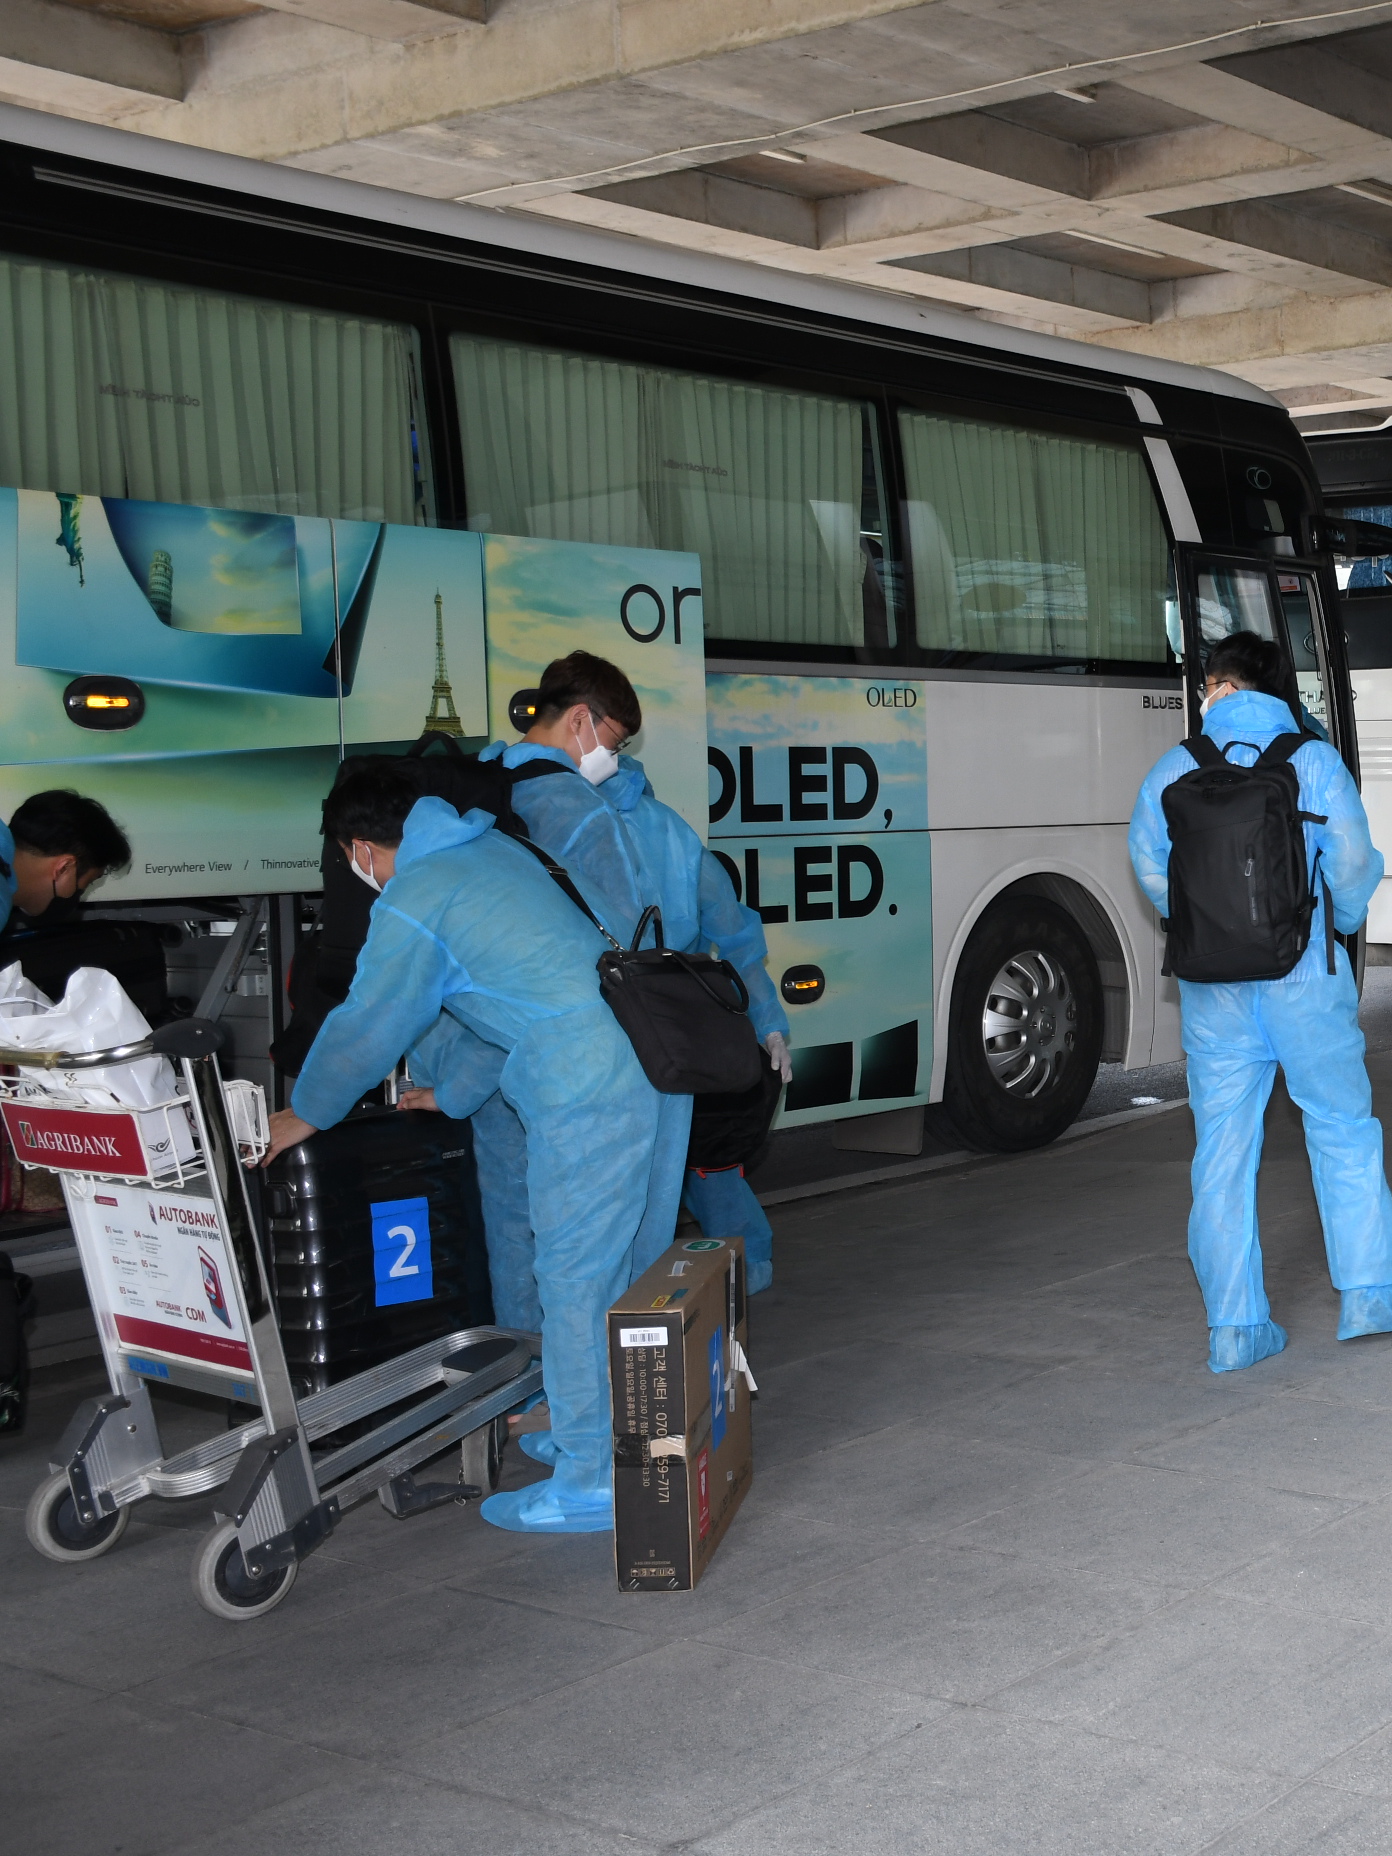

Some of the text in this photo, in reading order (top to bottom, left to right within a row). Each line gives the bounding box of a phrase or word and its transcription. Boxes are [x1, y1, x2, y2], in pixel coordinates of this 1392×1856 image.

[866, 686, 917, 708] OLED
[1141, 695, 1184, 710] BLUES
[145, 860, 206, 876] Everywhere
[208, 860, 232, 872] View
[260, 857, 320, 871] Thinnovative
[37, 1130, 122, 1157] AGRIBANK
[159, 1205, 218, 1230] AUTOBANK
[387, 1225, 419, 1278] 2
[185, 1306, 207, 1323] CDM
[652, 1347, 667, 1372] 고객
[653, 1375, 668, 1400] 센터
[712, 1359, 723, 1419] 2
